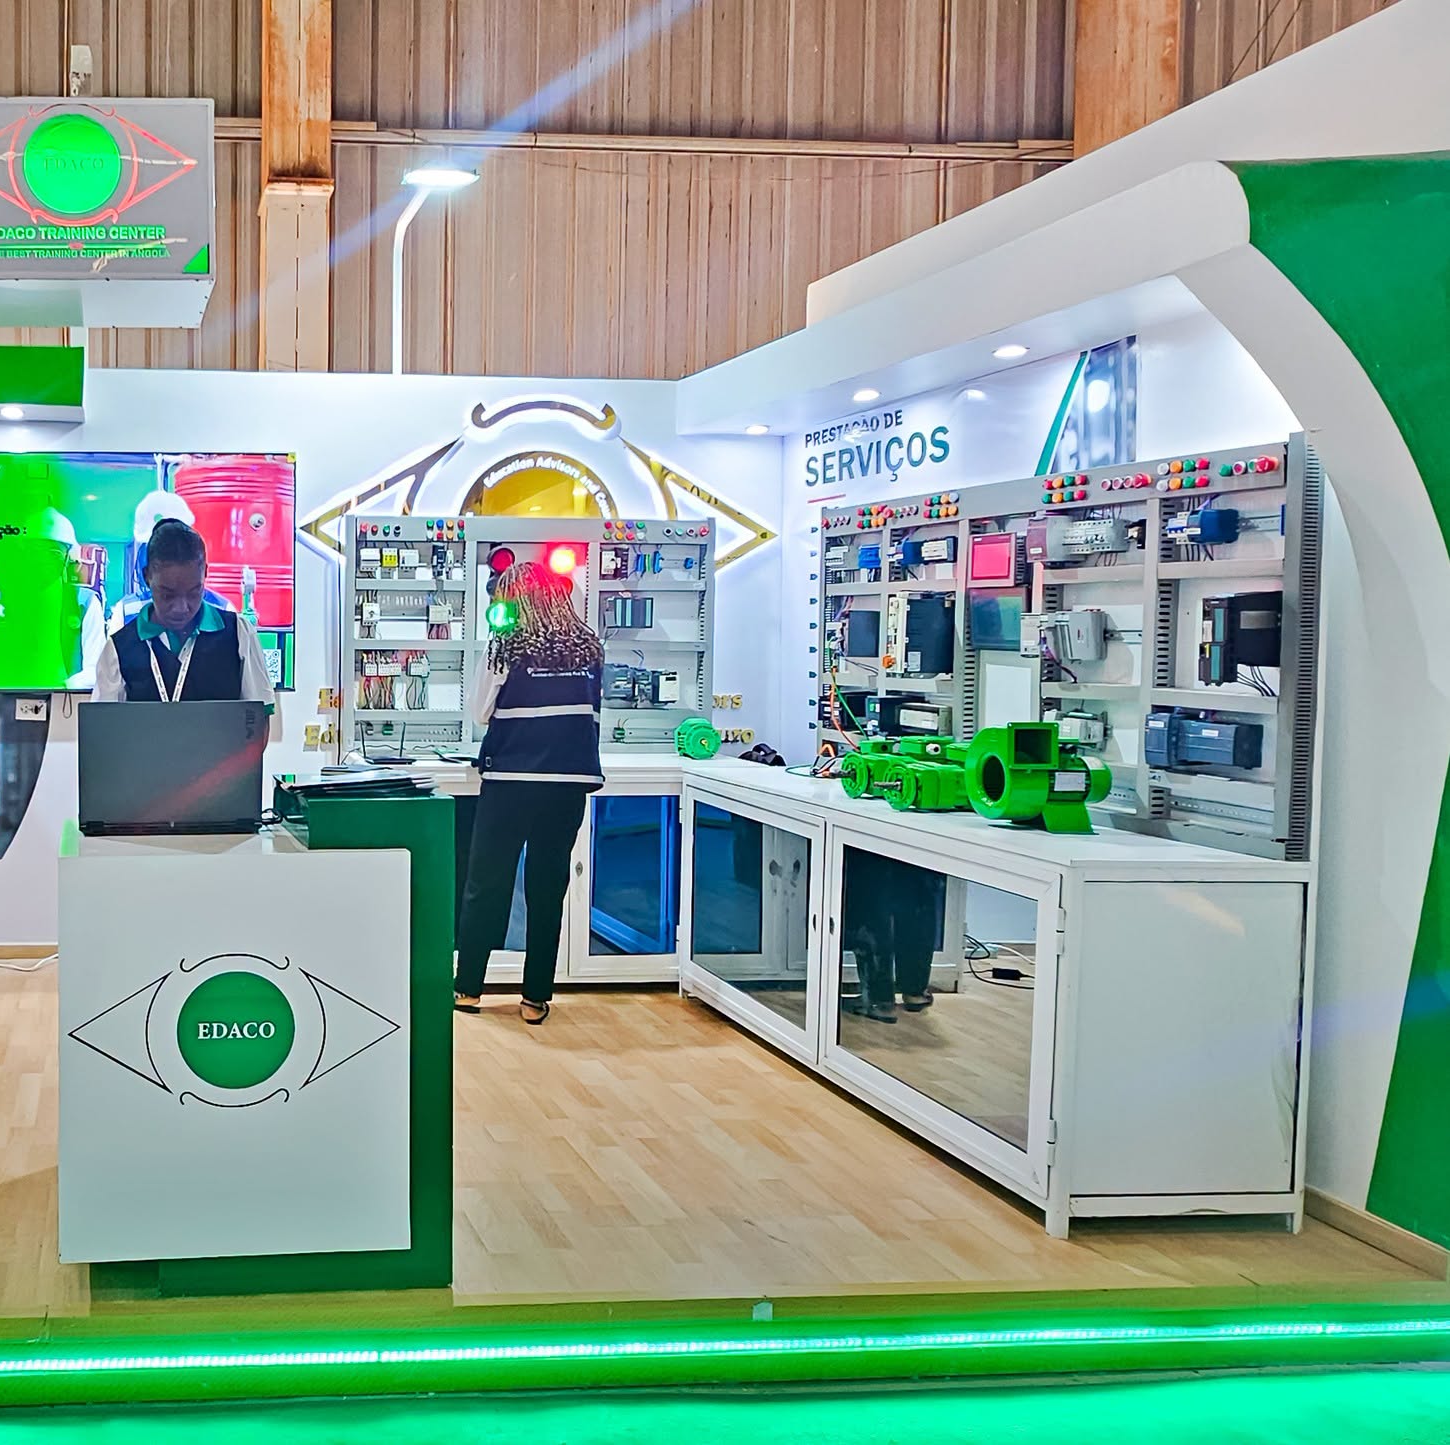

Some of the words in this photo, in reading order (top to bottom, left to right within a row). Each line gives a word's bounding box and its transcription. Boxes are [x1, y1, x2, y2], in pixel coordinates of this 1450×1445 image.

[38, 226, 106, 240] TRAINING
[108, 226, 166, 239] CENTER
[6, 249, 31, 258] BEST
[33, 249, 78, 258] TRAINING
[80, 249, 118, 258] CENTER
[131, 249, 171, 258] ANGOLA
[883, 409, 903, 429] DE
[806, 425, 950, 487] SERVIÇOS
[483, 457, 535, 488] Education
[536, 456, 581, 479] Advisors
[580, 475, 601, 494] and
[198, 1022, 275, 1039] EDACO
